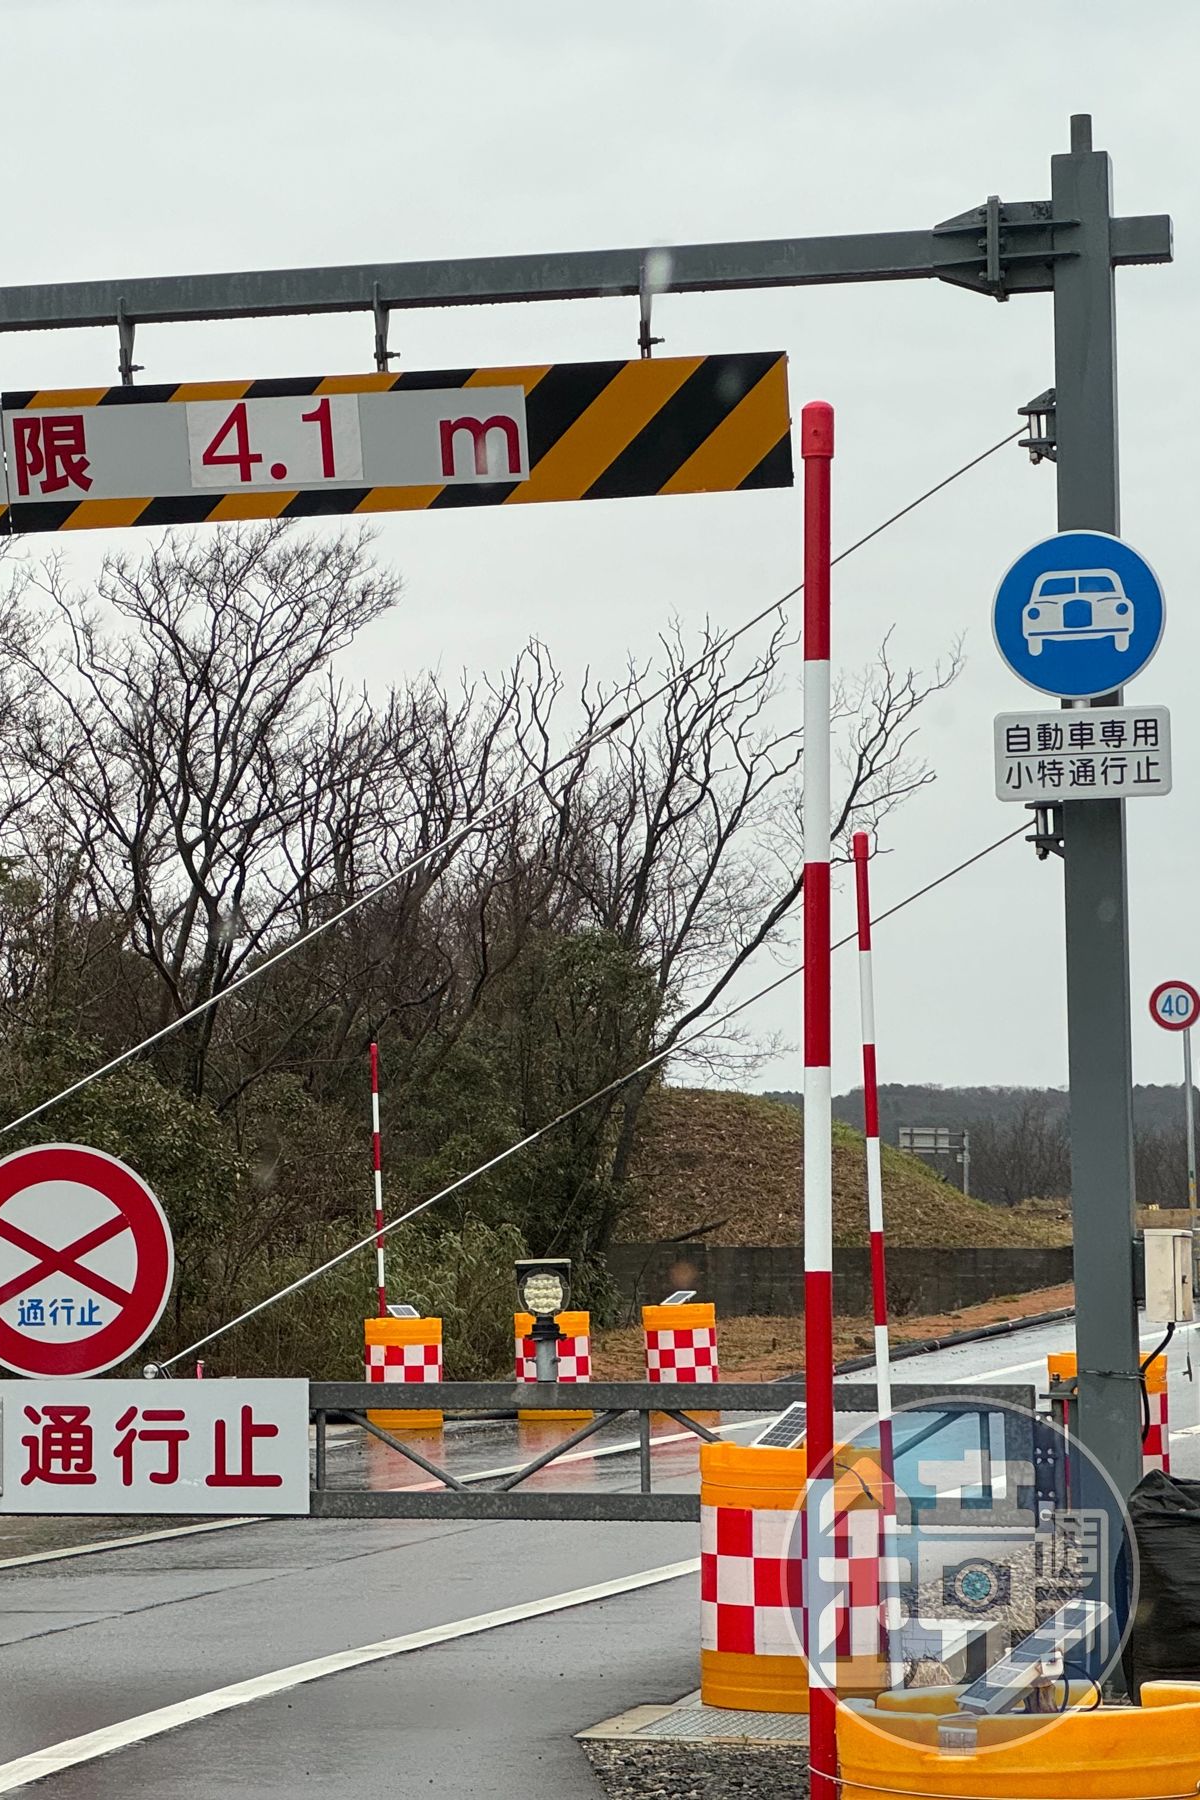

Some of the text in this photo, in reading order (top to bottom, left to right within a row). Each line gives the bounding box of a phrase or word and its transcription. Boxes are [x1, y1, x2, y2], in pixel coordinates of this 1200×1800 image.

[202, 398, 338, 483] 4.1
[439, 415, 520, 477] m
[1006, 719, 1159, 752] 自動車専用
[1006, 755, 1161, 790] 小特通行止
[1161, 995, 1189, 1016] 40
[17, 1298, 103, 1328] 通行止
[20, 1404, 283, 1488] 通行止
